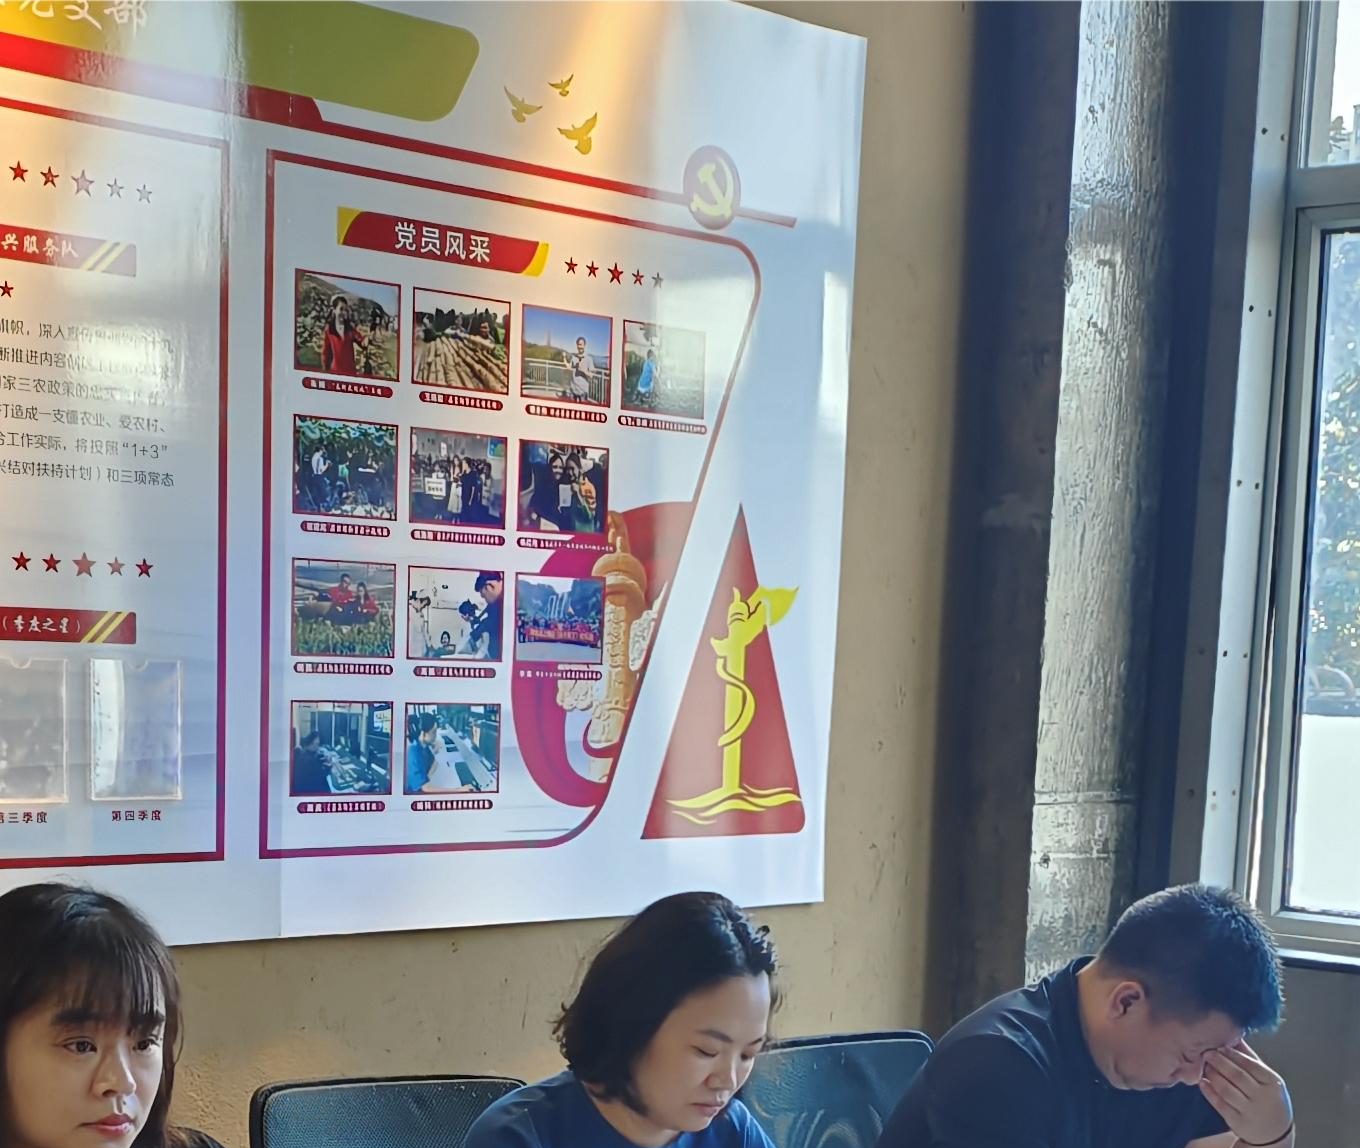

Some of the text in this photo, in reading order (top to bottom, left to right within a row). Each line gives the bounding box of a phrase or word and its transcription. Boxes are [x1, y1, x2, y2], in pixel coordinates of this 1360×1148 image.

[394, 221, 491, 264] 党员风采
[111, 808, 162, 823] 第四季度
